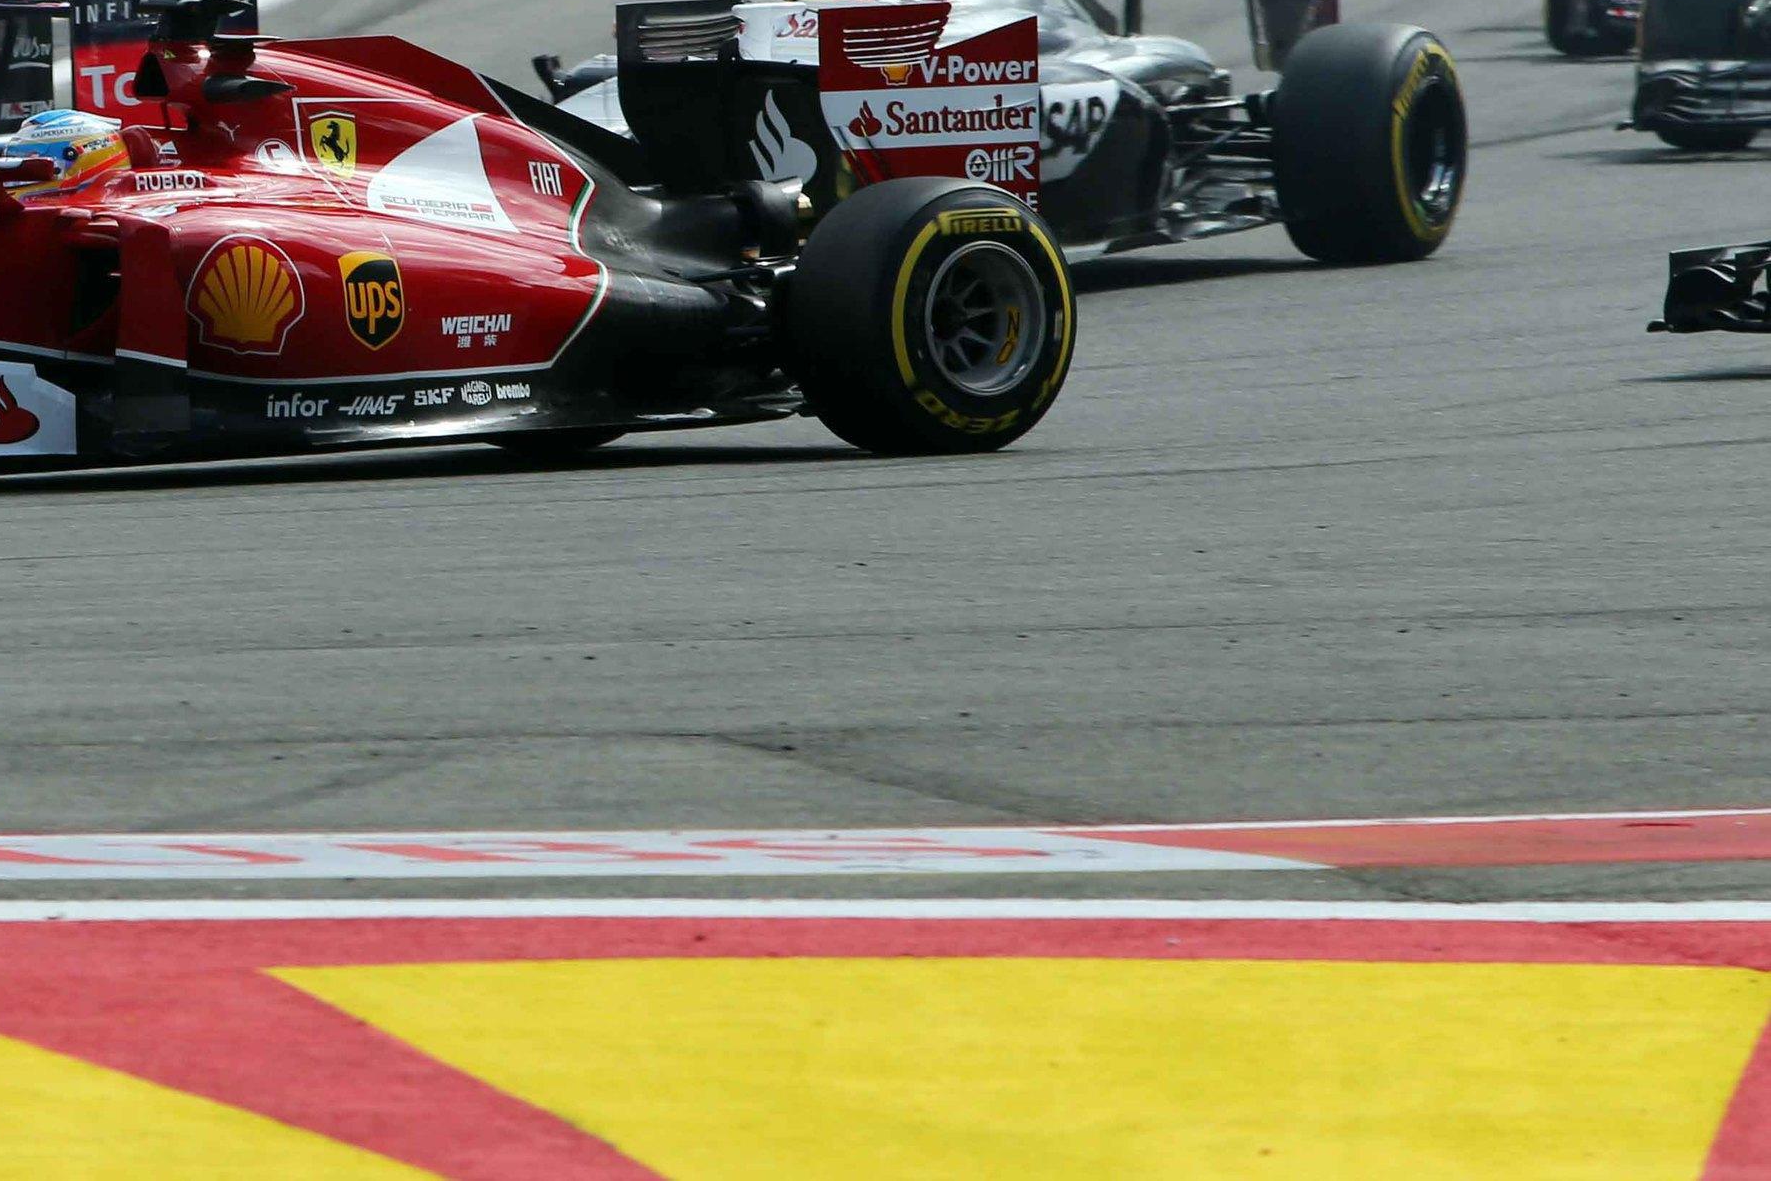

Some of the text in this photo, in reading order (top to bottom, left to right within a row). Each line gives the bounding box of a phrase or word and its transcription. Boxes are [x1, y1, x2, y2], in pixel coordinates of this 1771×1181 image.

[920, 56, 1036, 84] V-Power
[885, 95, 1037, 136] Santander
[135, 173, 206, 191] HUBLOT
[529, 161, 563, 196] FIAT
[380, 195, 469, 211] SCUDERIA
[420, 207, 496, 222] FERRARI
[938, 208, 1024, 235] PIRELLI
[348, 278, 400, 334] ups
[441, 314, 512, 335] WEICHAI
[414, 387, 455, 406] SKF
[495, 382, 531, 399] brembo
[267, 395, 328, 417] infor
[339, 395, 405, 416] HAAS
